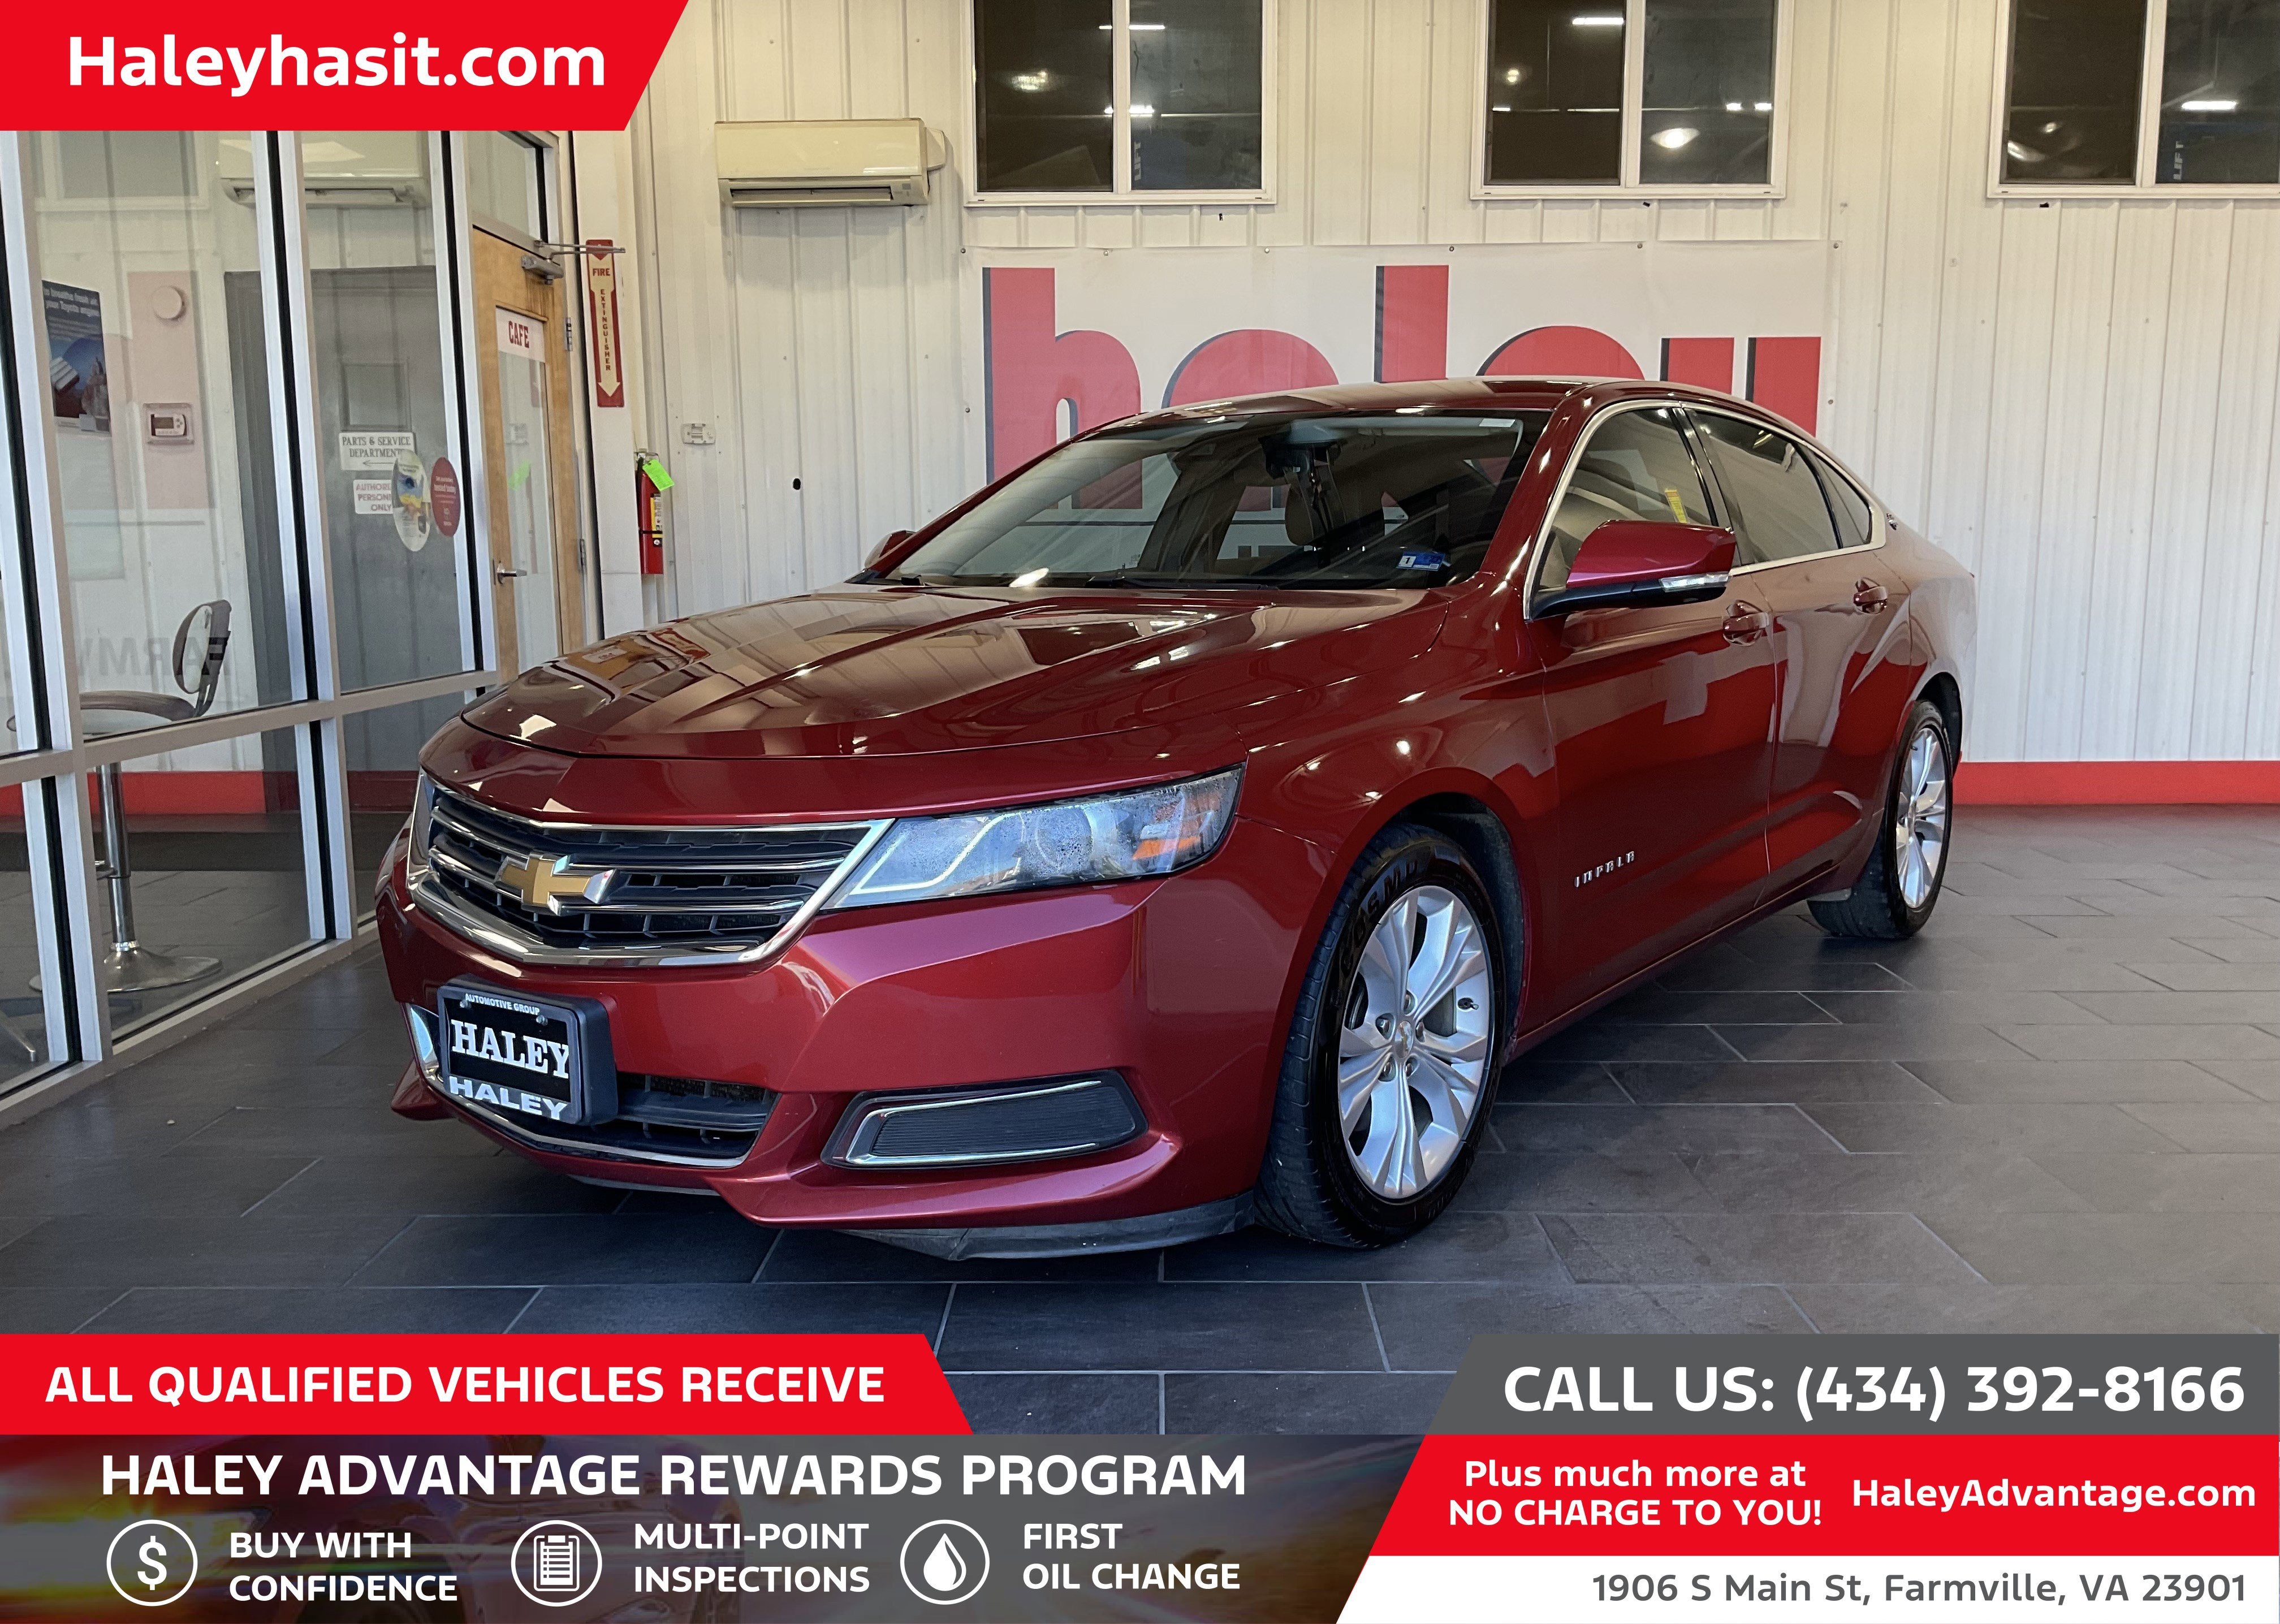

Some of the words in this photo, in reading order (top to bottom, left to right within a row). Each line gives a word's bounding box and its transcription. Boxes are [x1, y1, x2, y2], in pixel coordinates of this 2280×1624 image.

[593, 267, 611, 277] FIRE
[508, 320, 529, 348] CAFE
[600, 288, 611, 371] EXTINGUISHER
[342, 437, 366, 446] PARTS
[369, 437, 374, 445] &
[378, 437, 411, 446] SERVICE
[1574, 850, 1635, 888] IMPALA
[465, 993, 512, 1010] AUTOMOTIVE
[513, 1003, 540, 1016] GROUP
[451, 1019, 569, 1079] HALEY
[449, 1076, 567, 1120] HALEY
